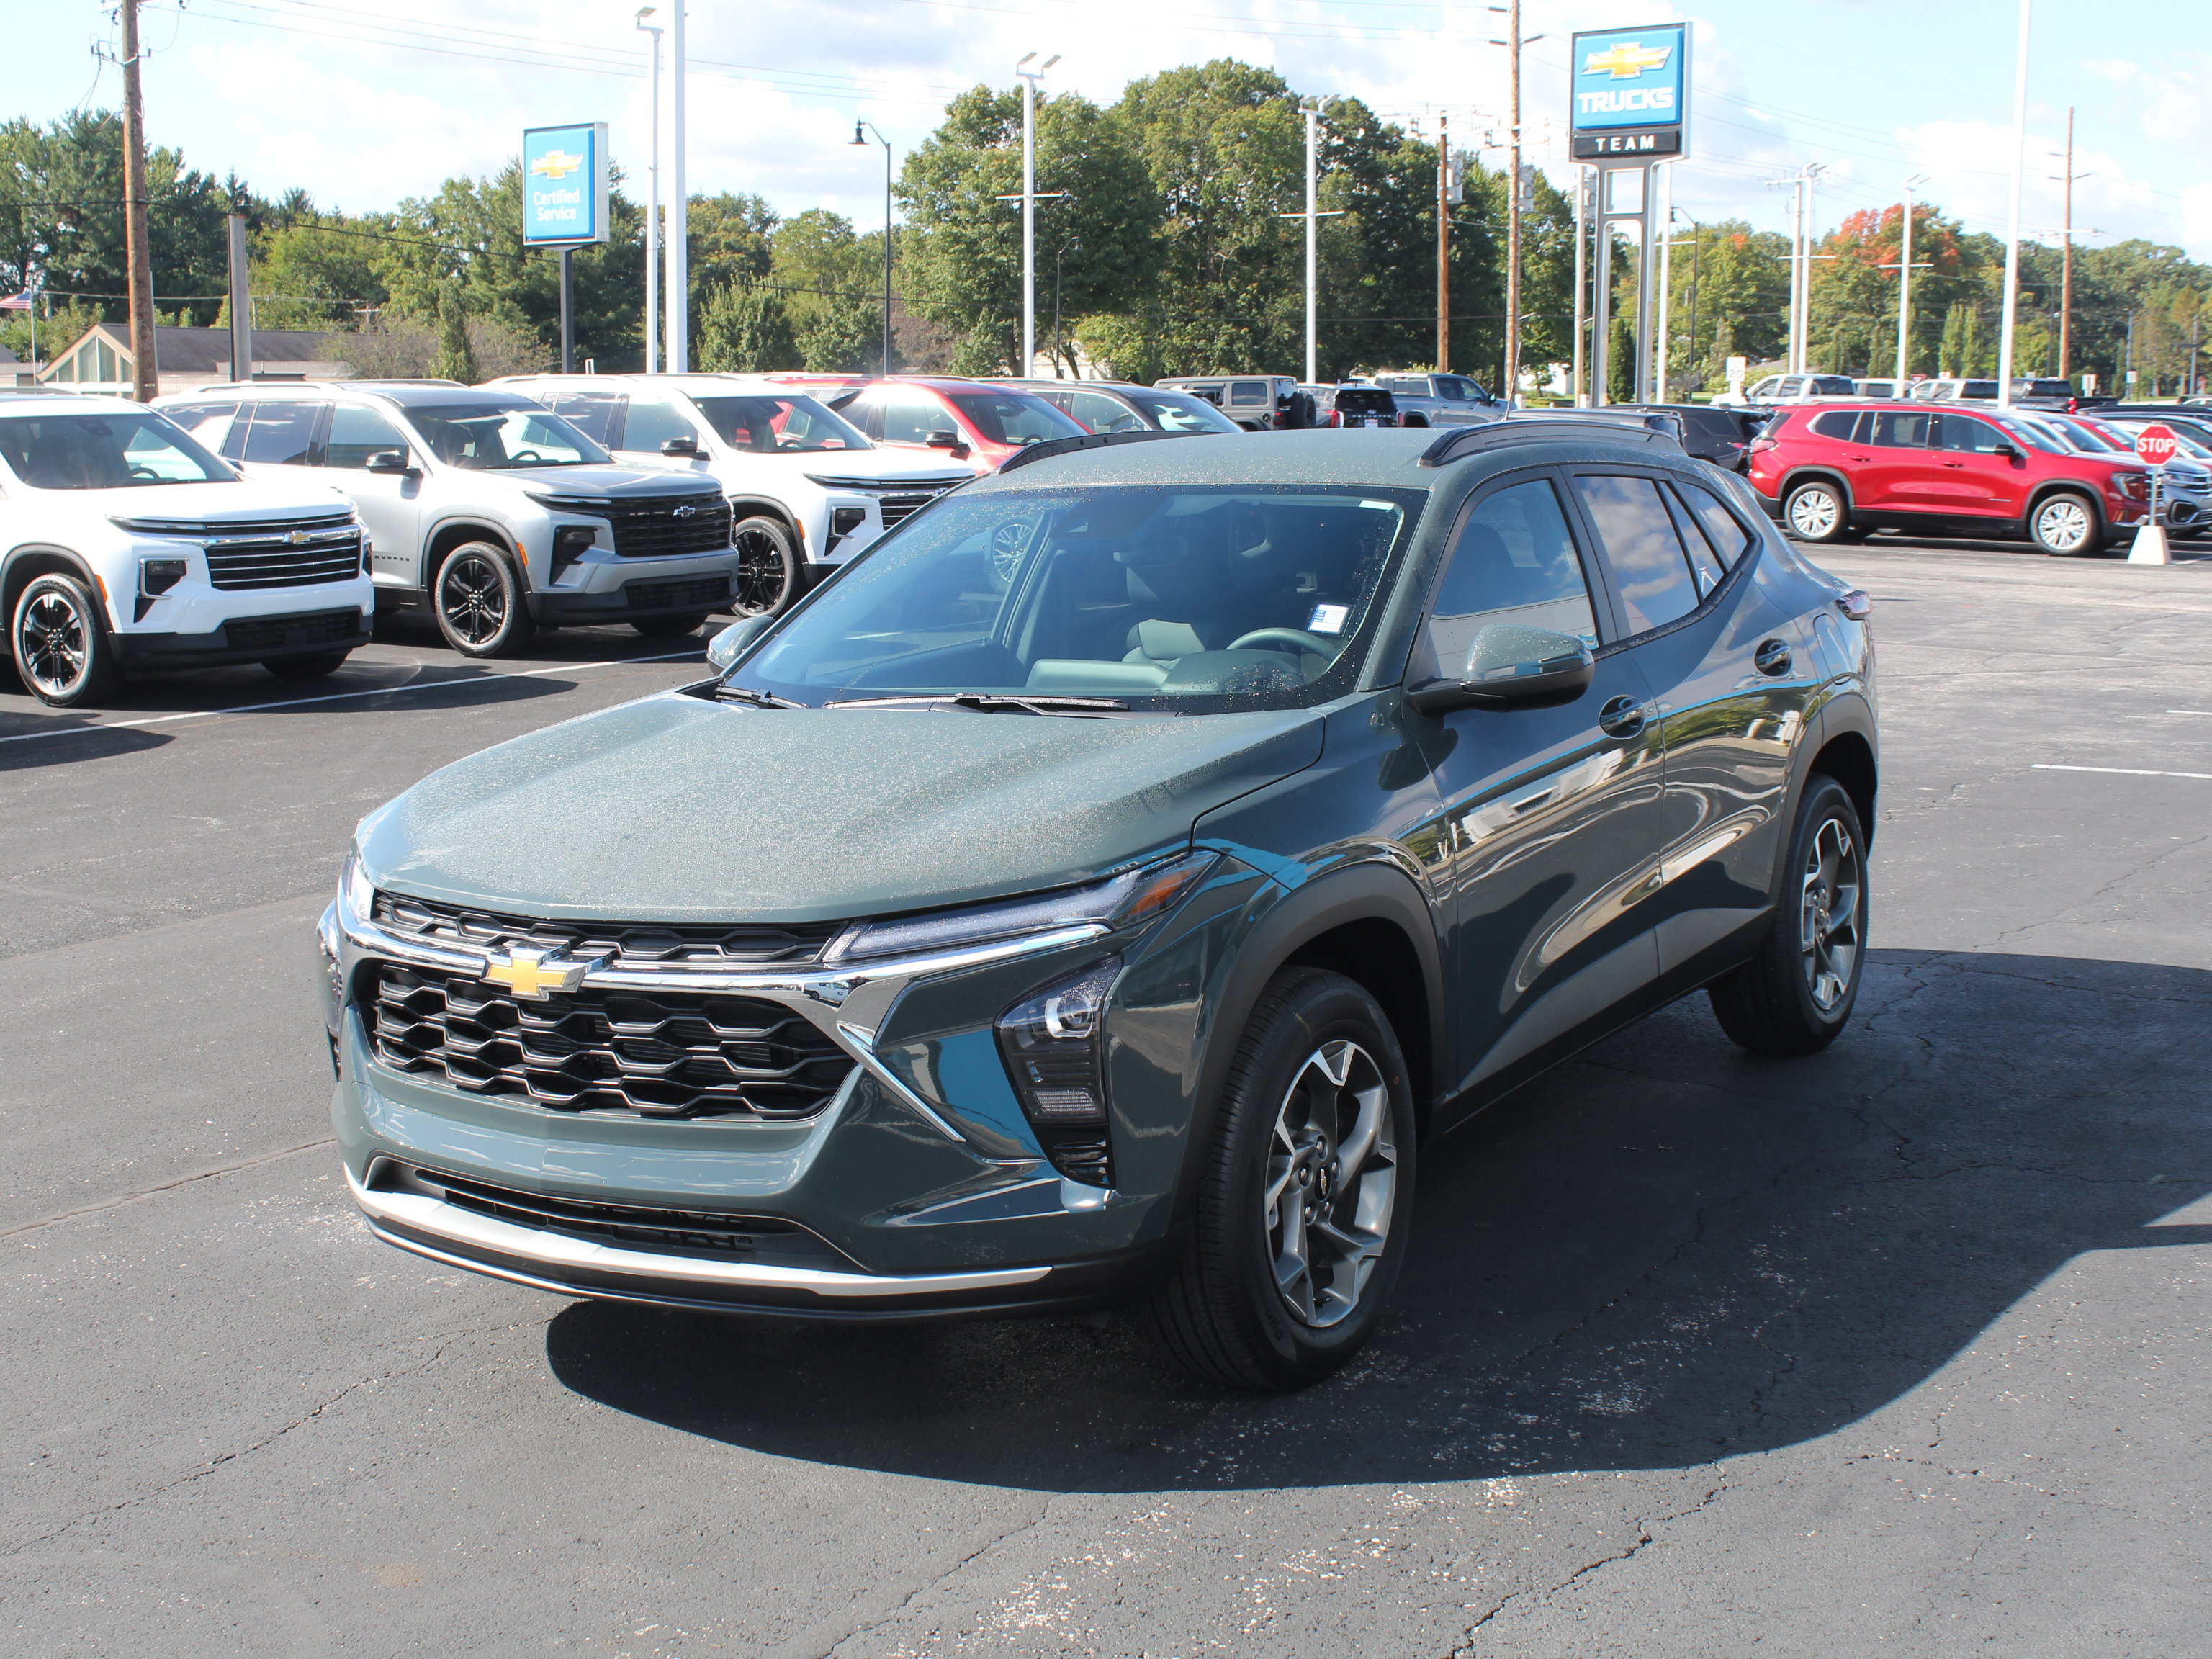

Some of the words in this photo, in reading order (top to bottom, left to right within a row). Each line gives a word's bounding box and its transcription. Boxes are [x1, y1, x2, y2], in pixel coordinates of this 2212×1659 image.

[1578, 87, 1673, 114] TRUCKS
[1596, 135, 1655, 152] TEAM
[533, 188, 580, 206] Certified
[536, 207, 577, 222] Service
[2137, 438, 2175, 454] STOP
